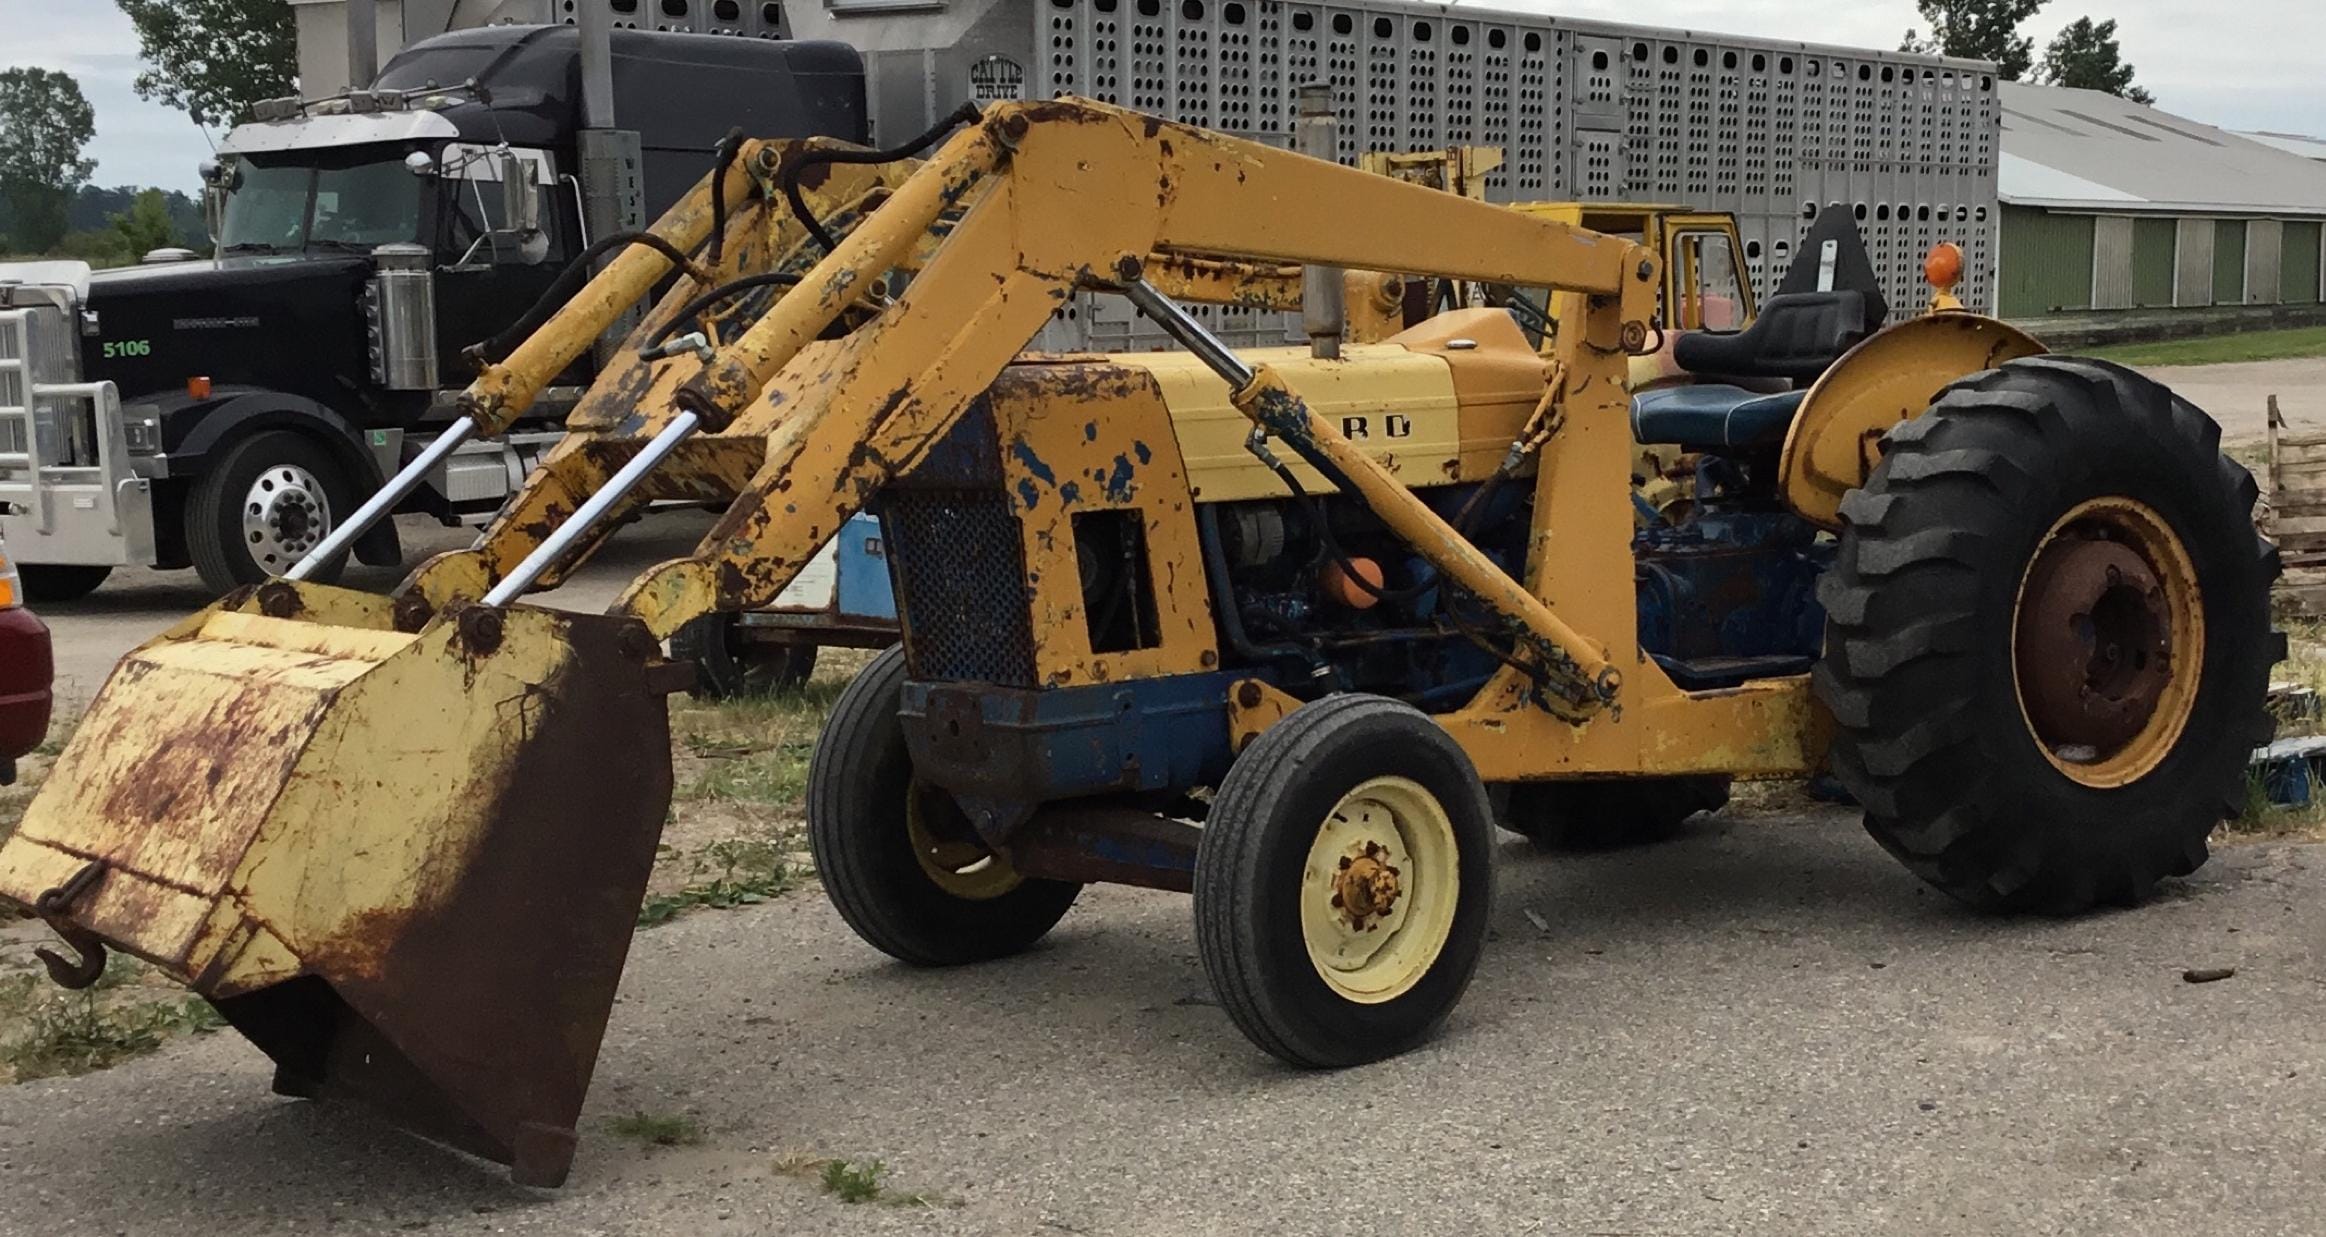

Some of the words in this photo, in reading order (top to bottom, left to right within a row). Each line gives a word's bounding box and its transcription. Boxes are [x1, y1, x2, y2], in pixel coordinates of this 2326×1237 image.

[971, 58, 1023, 84] CATTLE
[976, 85, 1018, 99] DRIVE
[103, 340, 151, 358] 5106
[1342, 415, 1411, 441] RD
